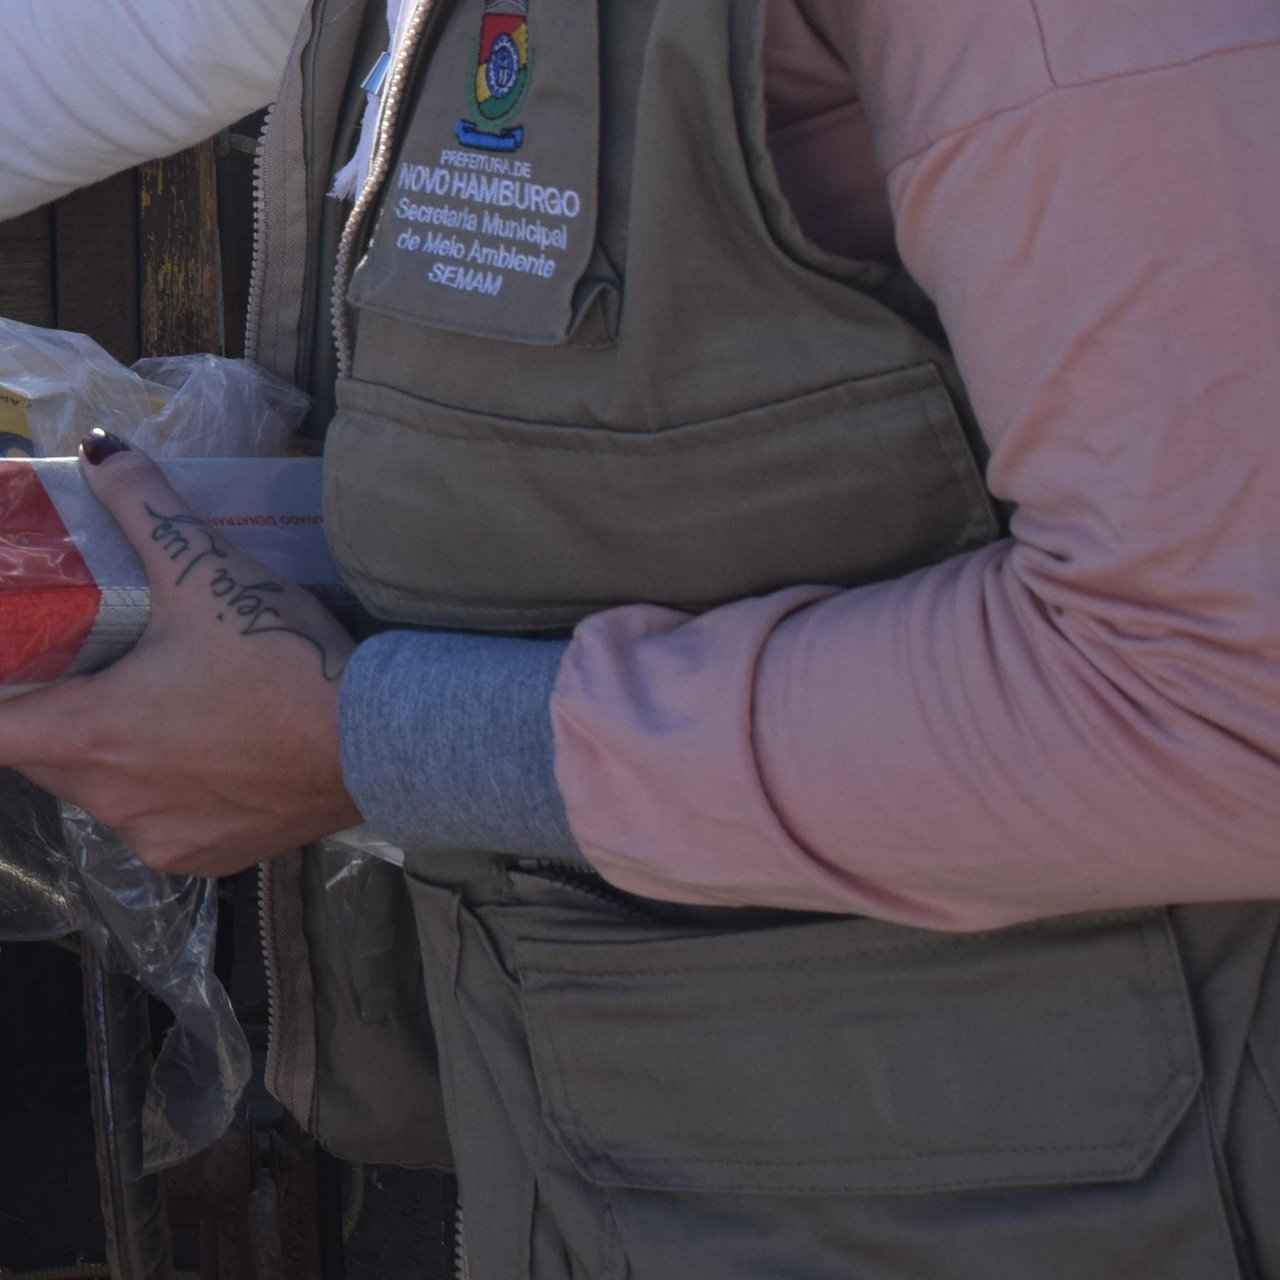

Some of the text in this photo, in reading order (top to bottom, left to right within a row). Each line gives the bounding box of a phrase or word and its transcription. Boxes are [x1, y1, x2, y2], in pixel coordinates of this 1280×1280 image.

[441, 149, 532, 178] PREFEITURA DE
[397, 162, 580, 218] NOVO HAMBURGO
[395, 197, 567, 250] Secretaria Municipal
[396, 227, 556, 278] de Meio Ambiente
[427, 261, 503, 296] SEMAM
